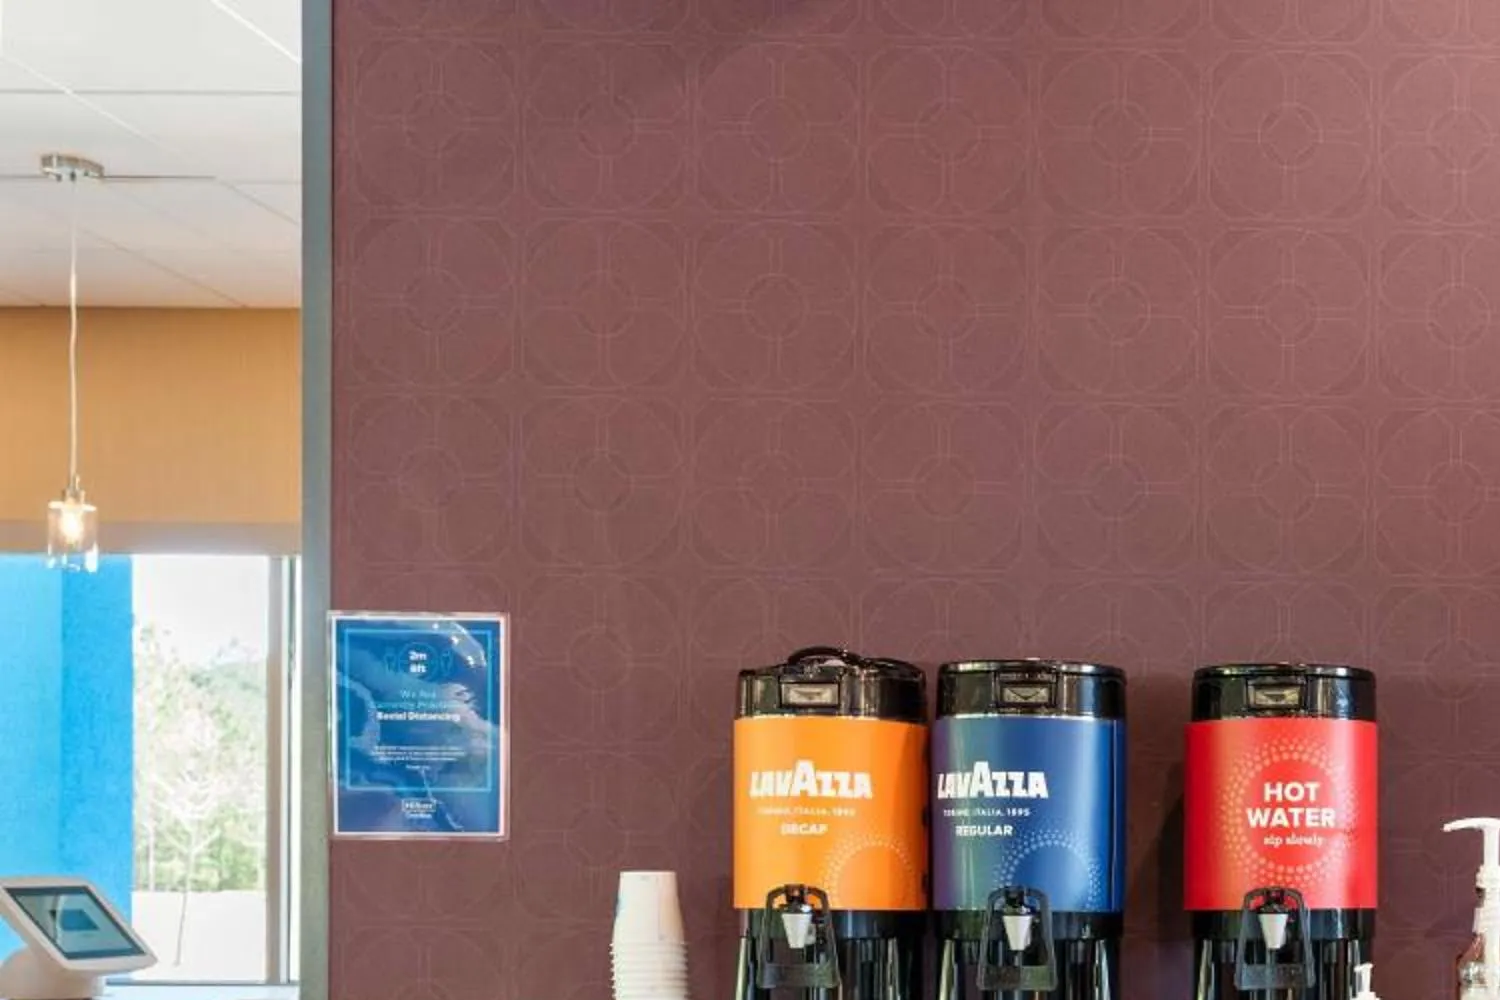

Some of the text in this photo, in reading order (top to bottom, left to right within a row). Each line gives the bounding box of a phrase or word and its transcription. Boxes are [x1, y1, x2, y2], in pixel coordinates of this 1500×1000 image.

[749, 760, 874, 799] LAVAZZA
[937, 760, 1049, 799] LAVAZZA
[1263, 782, 1320, 802] HOT
[1246, 807, 1337, 828] WATER
[955, 825, 1014, 837] REGULAR
